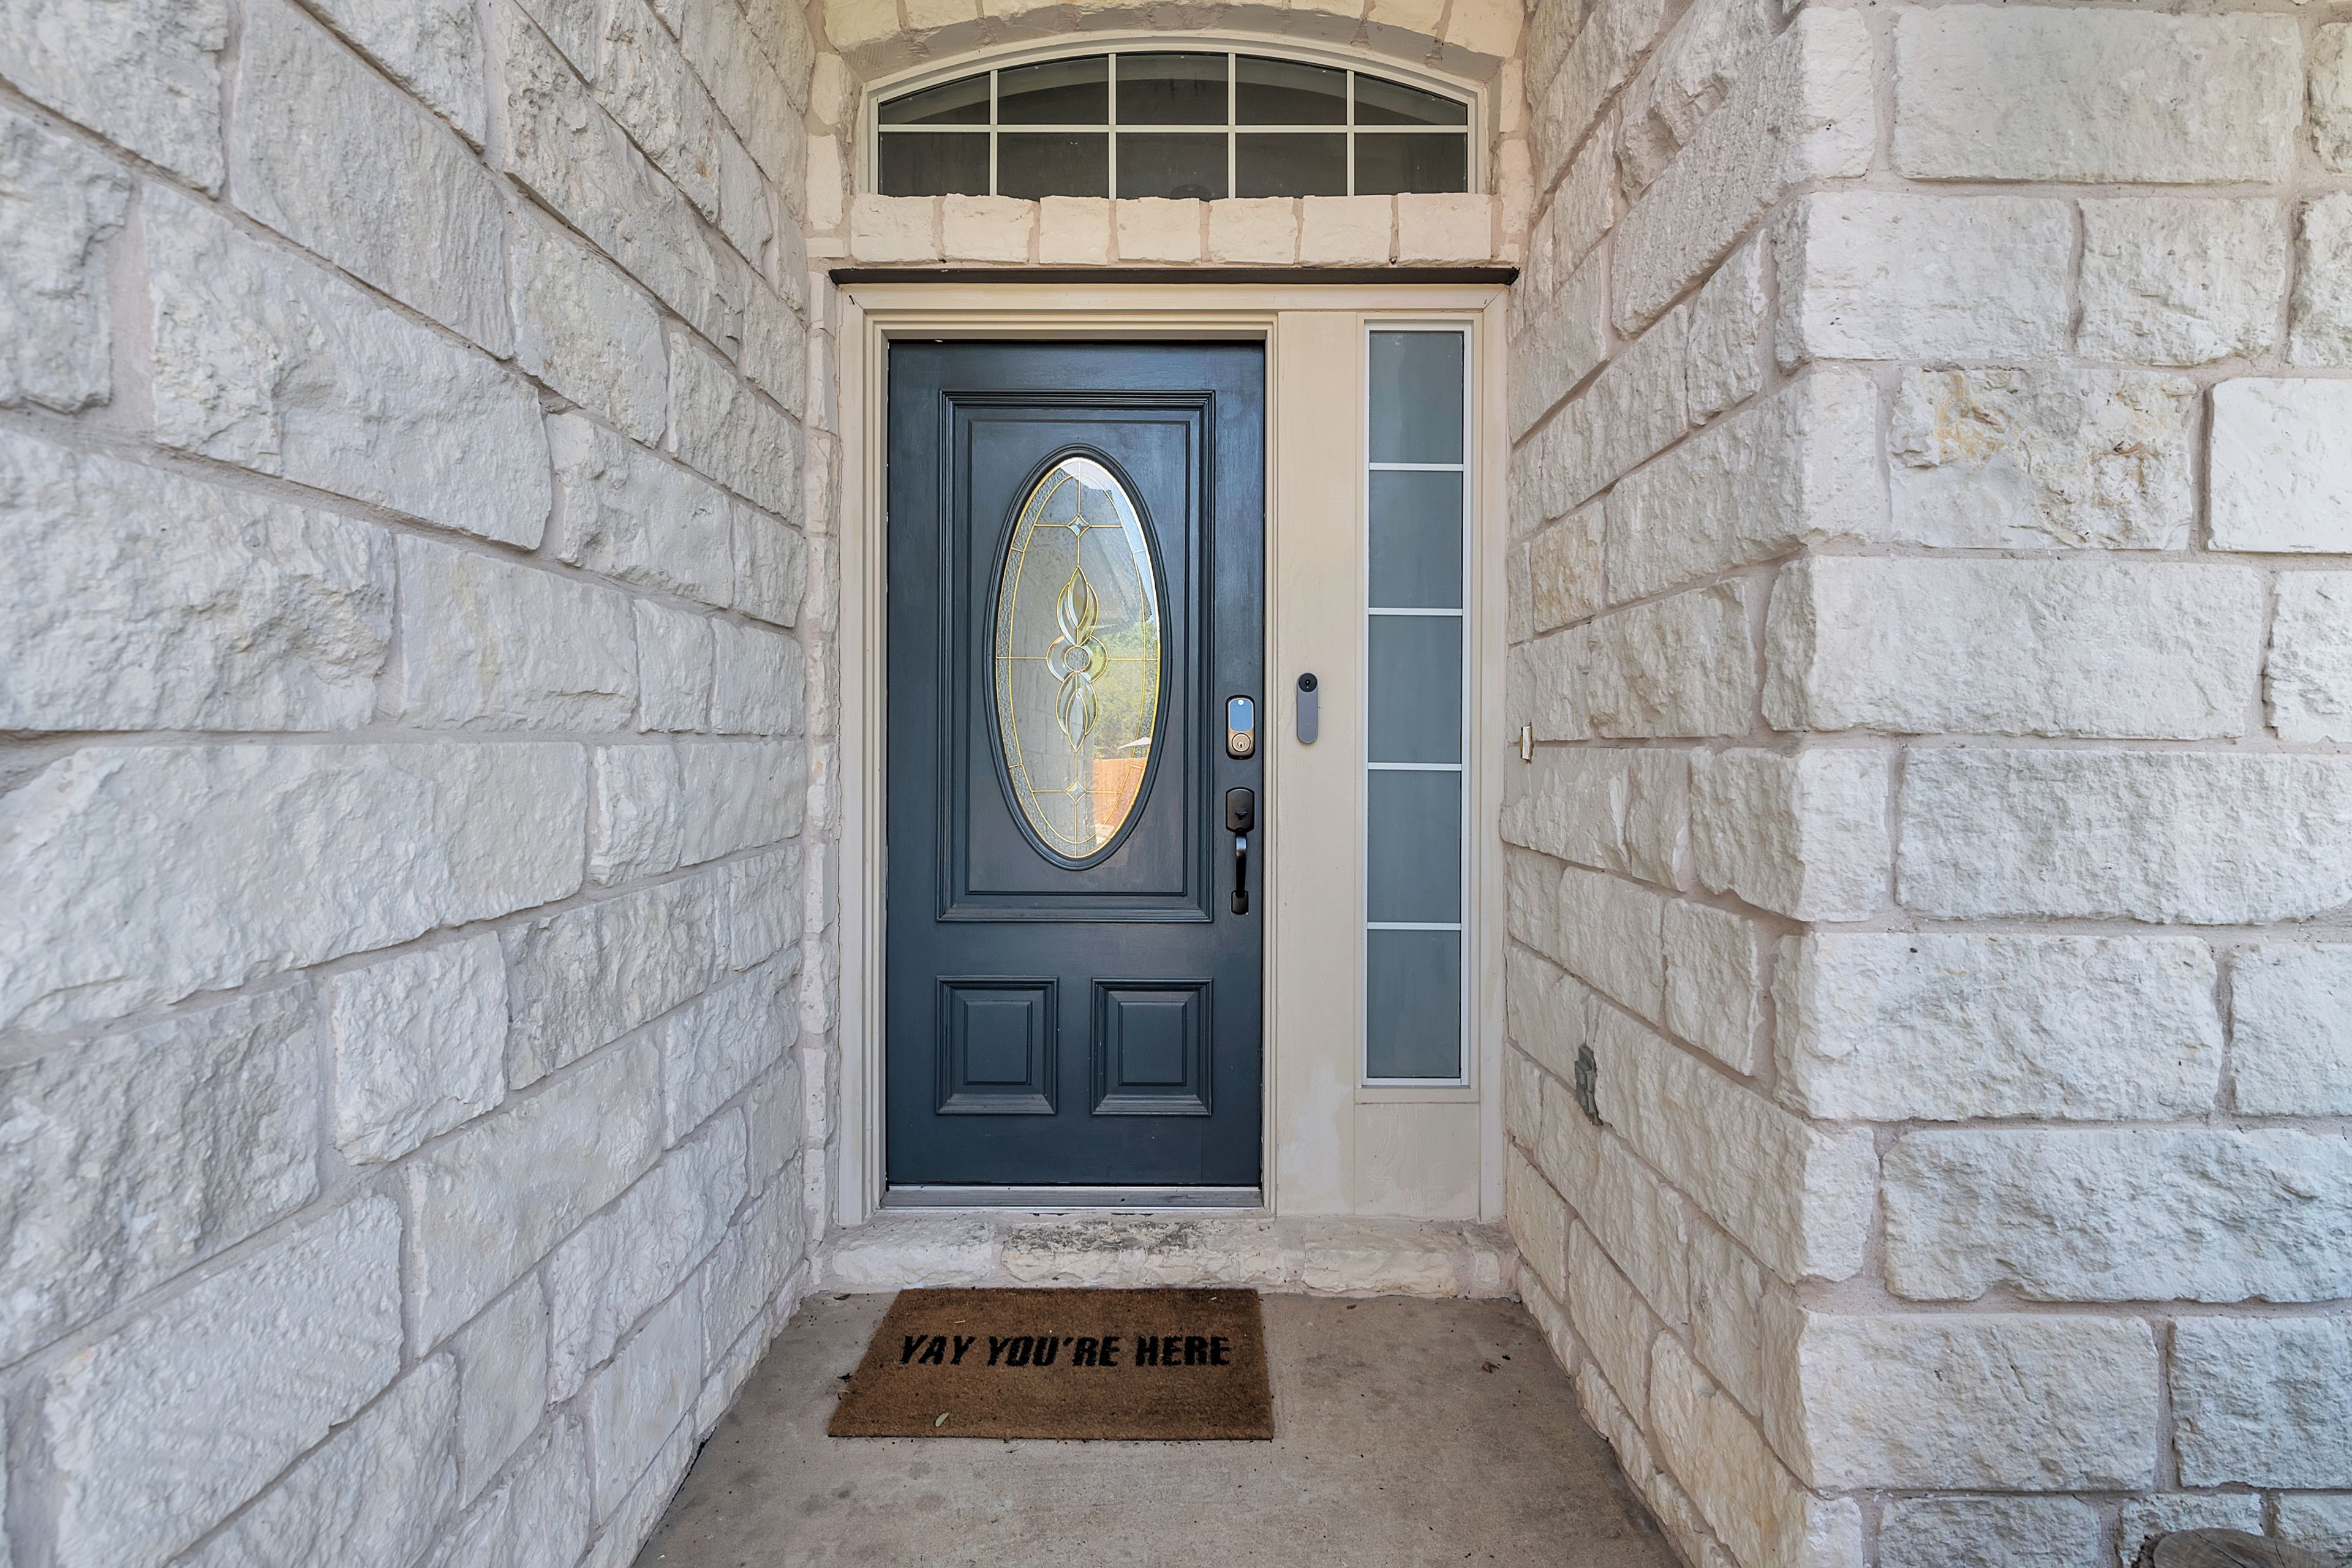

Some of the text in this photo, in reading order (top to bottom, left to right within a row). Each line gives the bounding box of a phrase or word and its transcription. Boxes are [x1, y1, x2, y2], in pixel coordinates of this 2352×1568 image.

[899, 1335, 1231, 1366] YAY YOU'RE HERE
